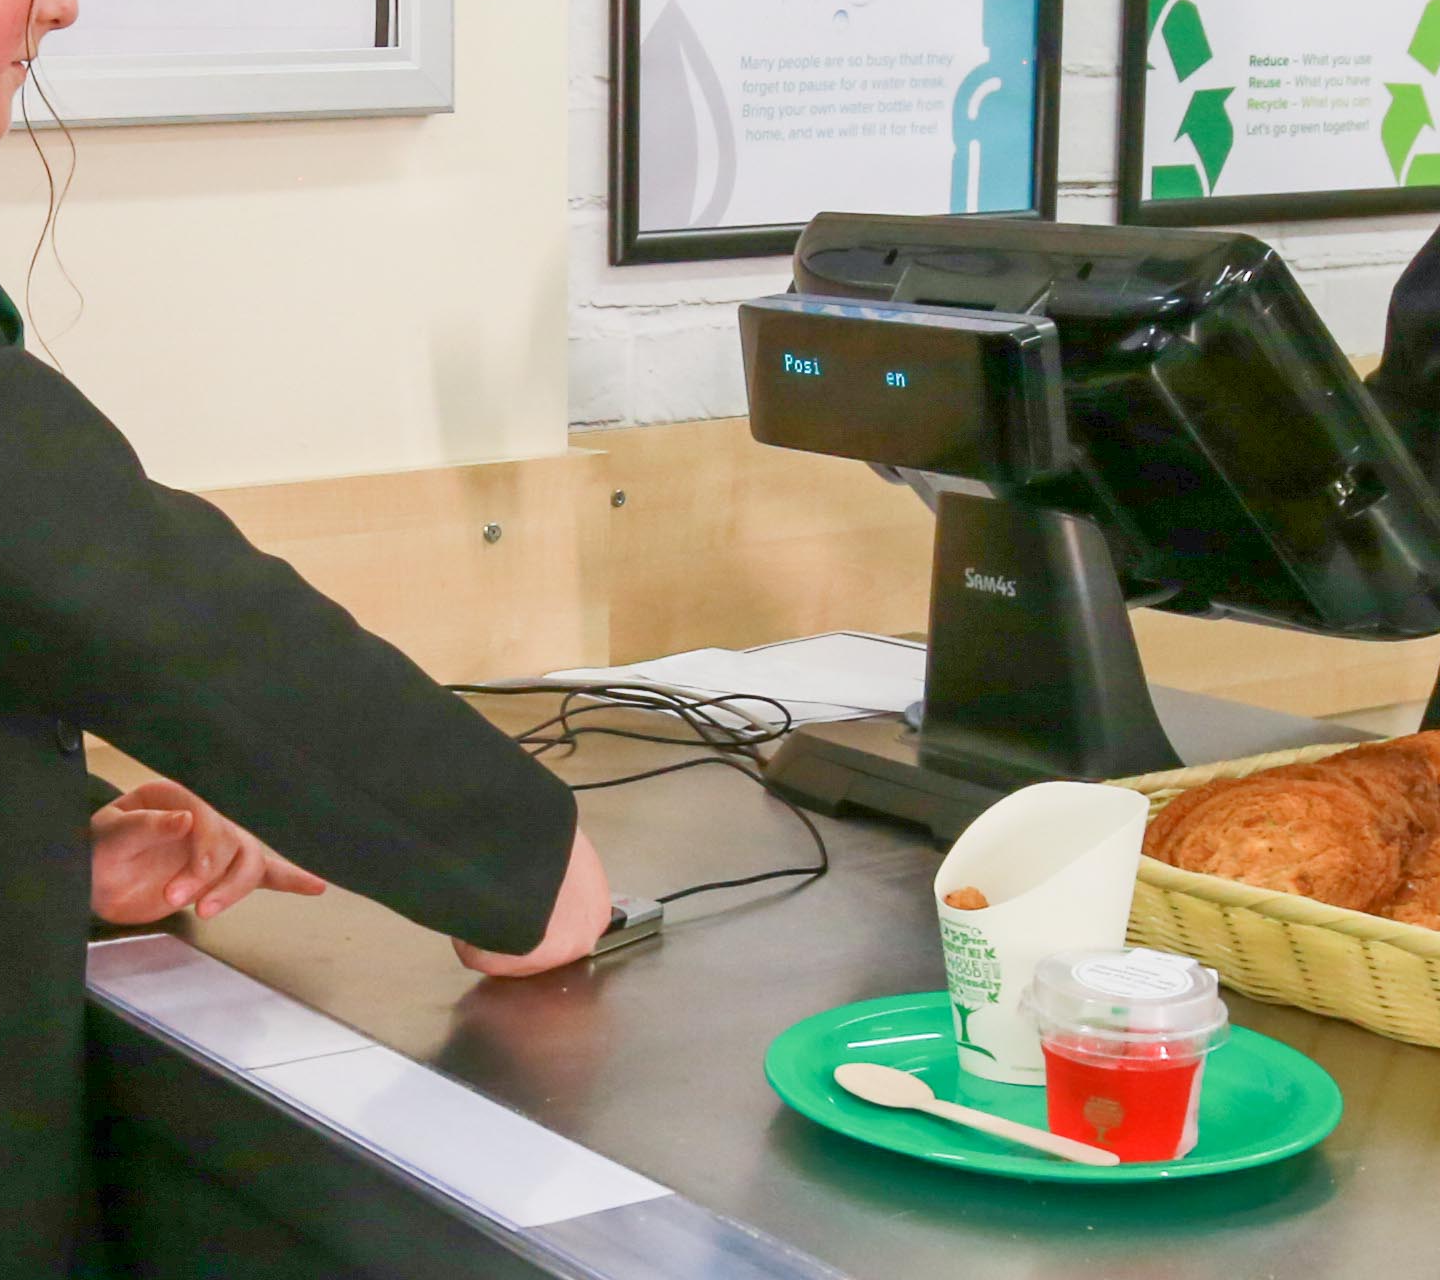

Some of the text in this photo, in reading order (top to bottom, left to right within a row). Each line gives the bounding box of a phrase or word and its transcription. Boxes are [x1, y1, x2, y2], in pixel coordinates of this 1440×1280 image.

[741, 55, 773, 72] Many
[778, 55, 821, 72] people
[1249, 55, 1289, 67] Reduce
[1249, 76, 1280, 88] Reuse
[741, 103, 775, 120] Bring
[1247, 97, 1289, 113] Recycle
[886, 370, 906, 388] en
